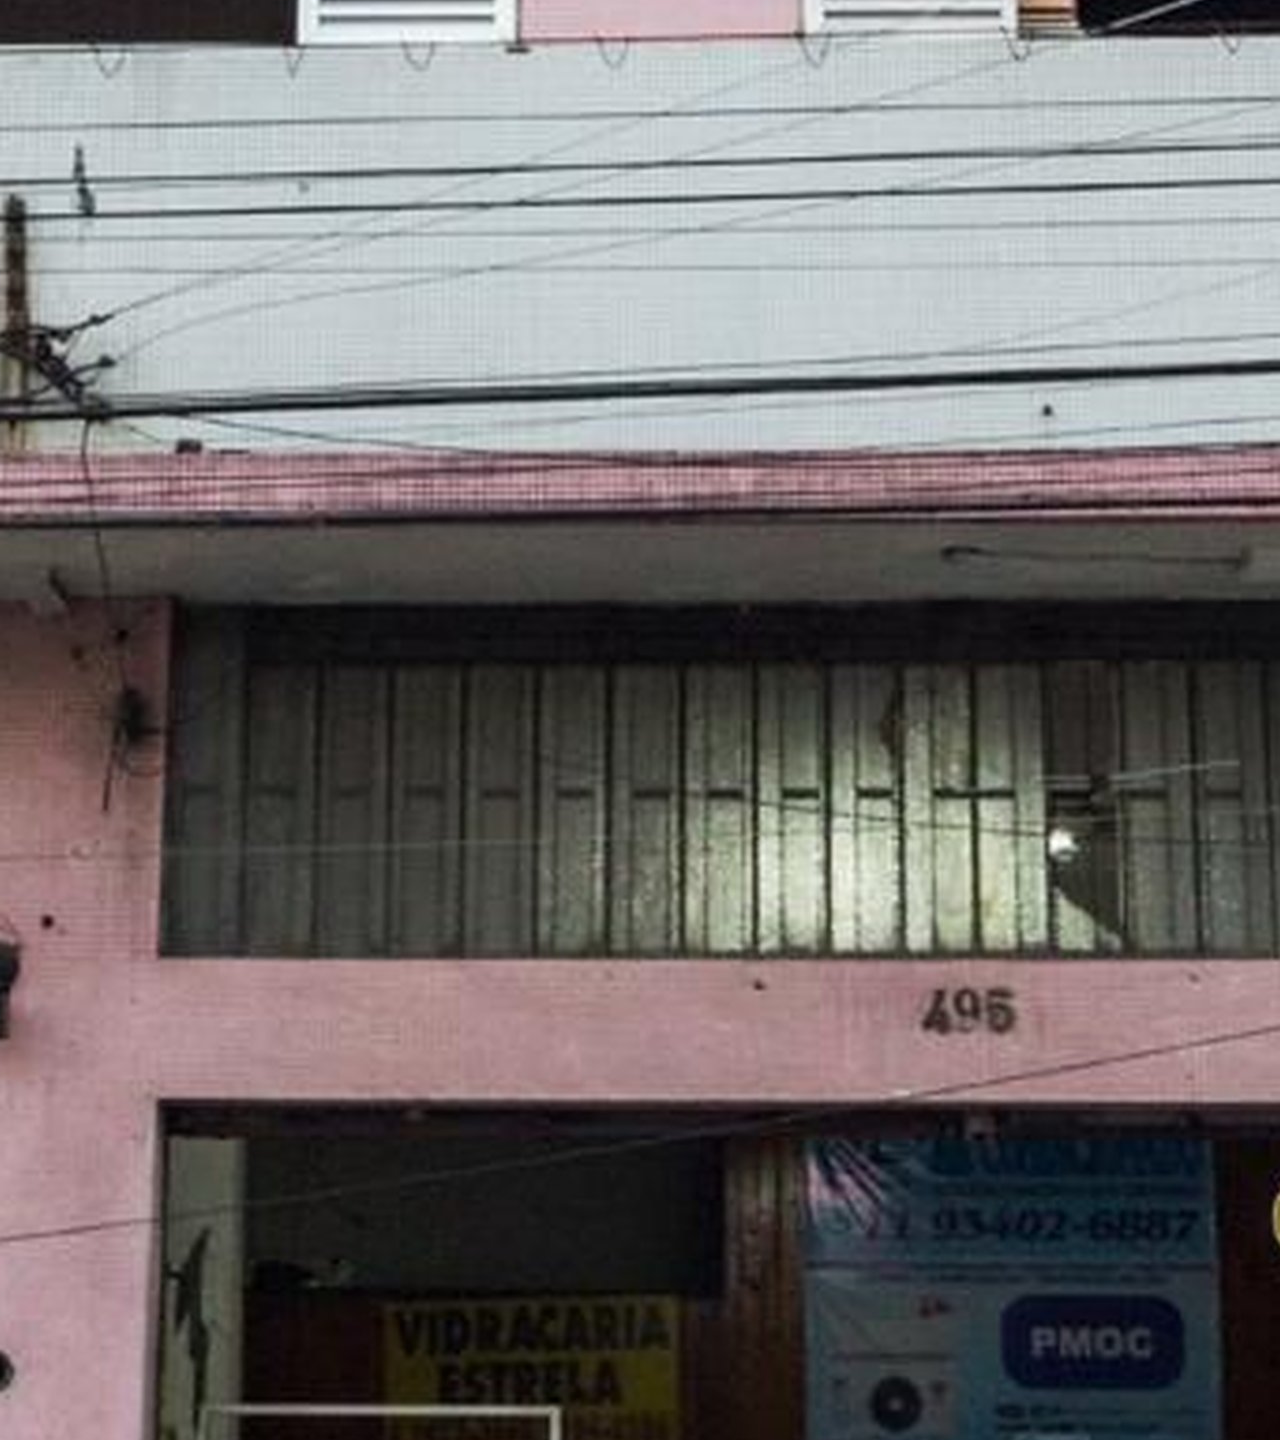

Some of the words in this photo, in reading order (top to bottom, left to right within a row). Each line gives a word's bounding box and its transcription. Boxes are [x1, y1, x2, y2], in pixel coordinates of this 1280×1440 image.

[922, 987, 1016, 1035] 495
[396, 1303, 672, 1356] VIDRACARIA
[1030, 1326, 1154, 1360] PMOC
[438, 1359, 623, 1404] ESTRELA
